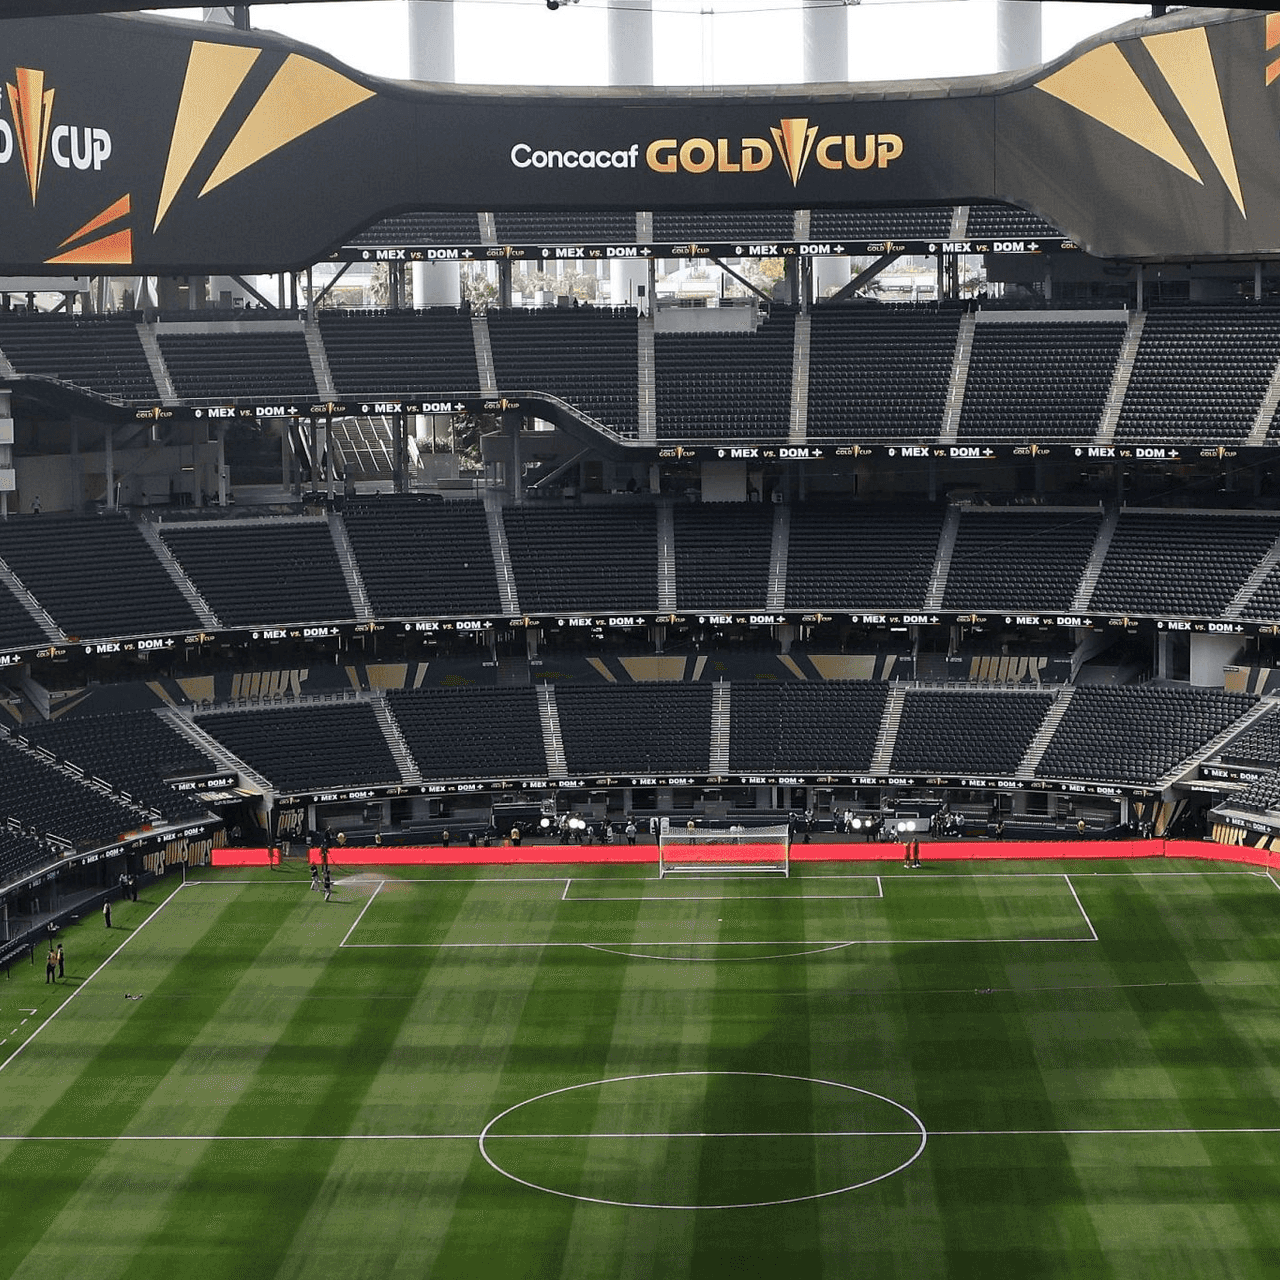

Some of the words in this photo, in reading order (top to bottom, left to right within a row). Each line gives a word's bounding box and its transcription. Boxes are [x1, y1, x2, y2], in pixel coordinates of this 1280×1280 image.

[51, 124, 112, 171] CUP
[510, 143, 639, 169] Concacaf
[645, 138, 773, 174] GOLD
[816, 133, 904, 171] CUP
[556, 248, 584, 257] MEX
[607, 248, 636, 256] DOM
[750, 245, 778, 254] MEX
[800, 245, 830, 255] DOM
[943, 243, 971, 252] MEX
[994, 242, 1025, 253] DOM
[377, 250, 405, 259] MEX
[428, 249, 458, 258] DOM
[209, 408, 235, 417] MEX
[256, 407, 285, 417] DOM
[731, 449, 758, 457] MEX
[780, 449, 810, 458] DOM
[1089, 448, 1115, 456] MEX
[1136, 448, 1164, 457] DOM
[863, 614, 885, 623] MEX
[904, 616, 929, 624] DOM
[1057, 617, 1080, 626] DOM
[265, 629, 286, 638] MEX
[304, 628, 328, 638] DOM
[97, 643, 120, 653] MEX
[138, 639, 163, 650] DOM
